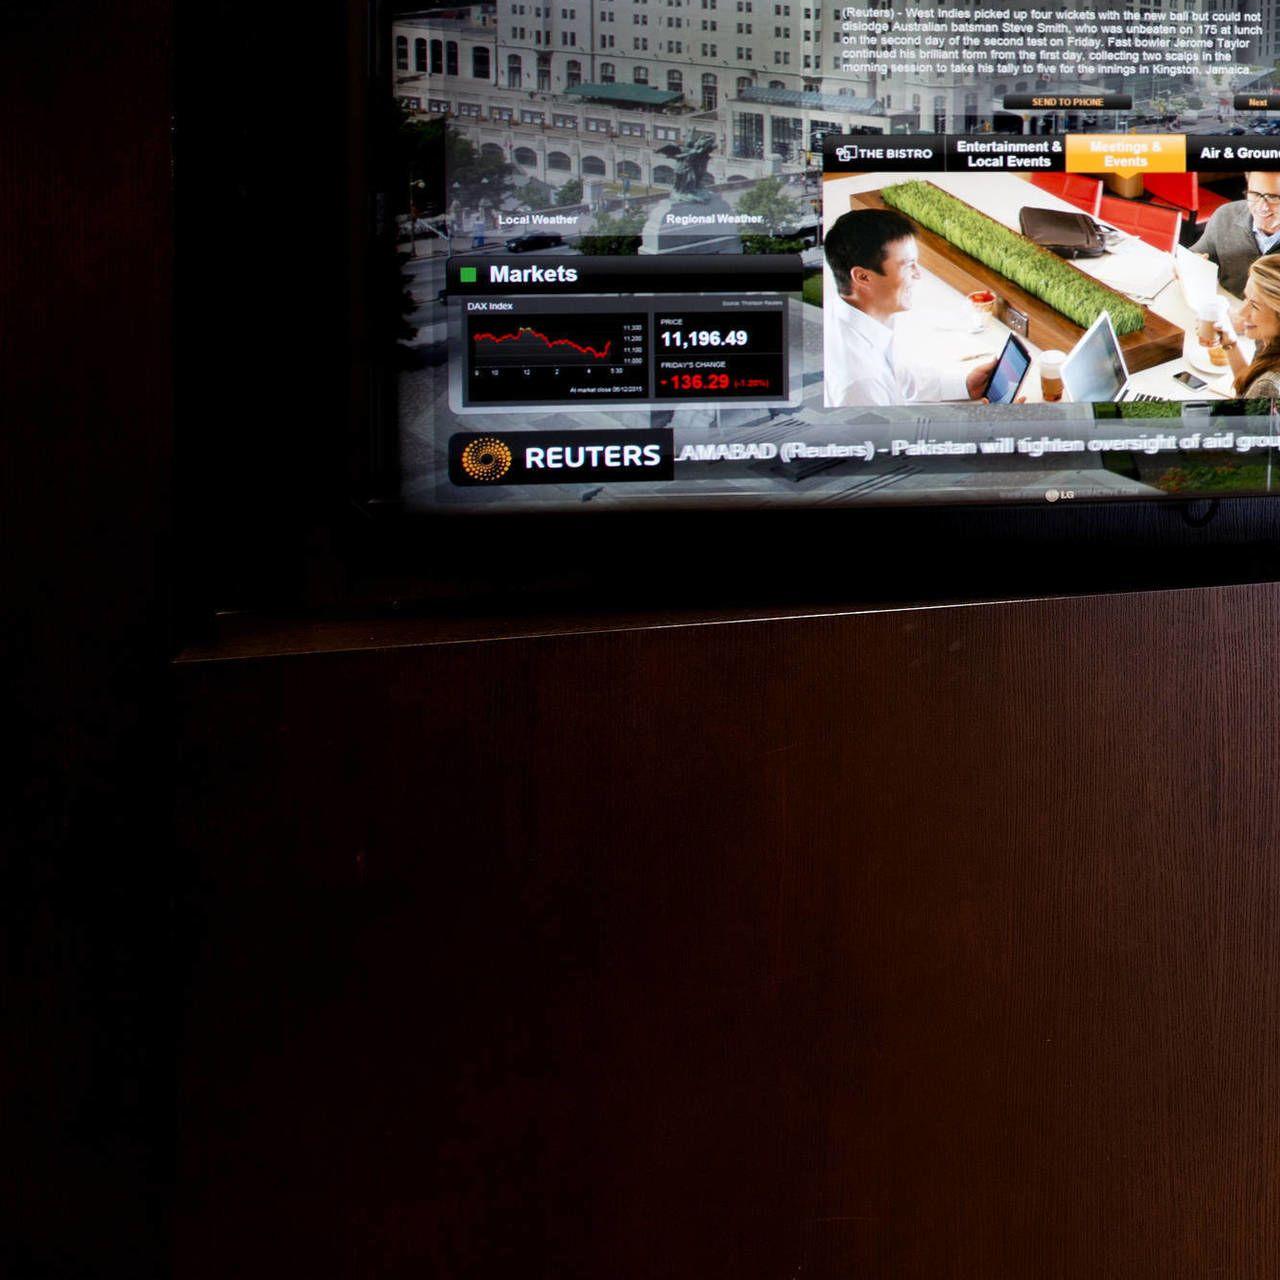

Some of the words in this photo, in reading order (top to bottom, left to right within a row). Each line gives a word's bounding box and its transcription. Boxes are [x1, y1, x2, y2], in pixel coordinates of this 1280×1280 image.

[842, 7, 895, 19] (Reuters)
[905, 8, 935, 18] West
[938, 8, 971, 19] Indies
[974, 9, 1010, 21] picked
[1013, 10, 1027, 21] up
[1030, 9, 1052, 19] four
[1055, 10, 1096, 20] wickets
[1098, 10, 1120, 20] with
[1123, 11, 1140, 21] the
[1144, 12, 1167, 21] new
[1170, 11, 1189, 21] ball
[1191, 11, 1209, 21] but
[1212, 11, 1241, 22] could
[1244, 12, 1262, 22] not
[1032, 98, 1057, 106] SEND
[1059, 98, 1071, 106] TO
[1073, 98, 1104, 107] PHONE
[1249, 98, 1267, 107] Next
[957, 141, 1049, 153] Entertainment
[1051, 141, 1062, 152] &
[1091, 141, 1148, 154] Meetings
[1151, 141, 1162, 152] &
[859, 149, 883, 159] THE
[886, 149, 933, 160] BISTRO
[1201, 148, 1221, 159] Air
[1223, 148, 1234, 159] &
[968, 155, 1003, 167] Local
[1007, 155, 1052, 167] Events
[1105, 155, 1148, 167] Events
[499, 215, 530, 226] Local
[532, 214, 578, 225] Weather
[666, 214, 714, 226] Regional
[716, 214, 763, 225] Weather
[490, 265, 578, 283] Markets
[467, 302, 487, 310] DAX
[489, 302, 513, 310] Index
[661, 330, 748, 349] 11,196.49
[671, 374, 730, 389] 136.29
[776, 440, 874, 463] (Reuters)
[891, 440, 977, 457] Pakistan
[981, 437, 1014, 454] will
[1018, 436, 1084, 458] tighten
[1088, 434, 1177, 454] oversight
[1179, 433, 1201, 450] of
[1202, 432, 1234, 449] aid
[525, 445, 661, 469] REUTERS
[1060, 490, 1075, 500] LG
